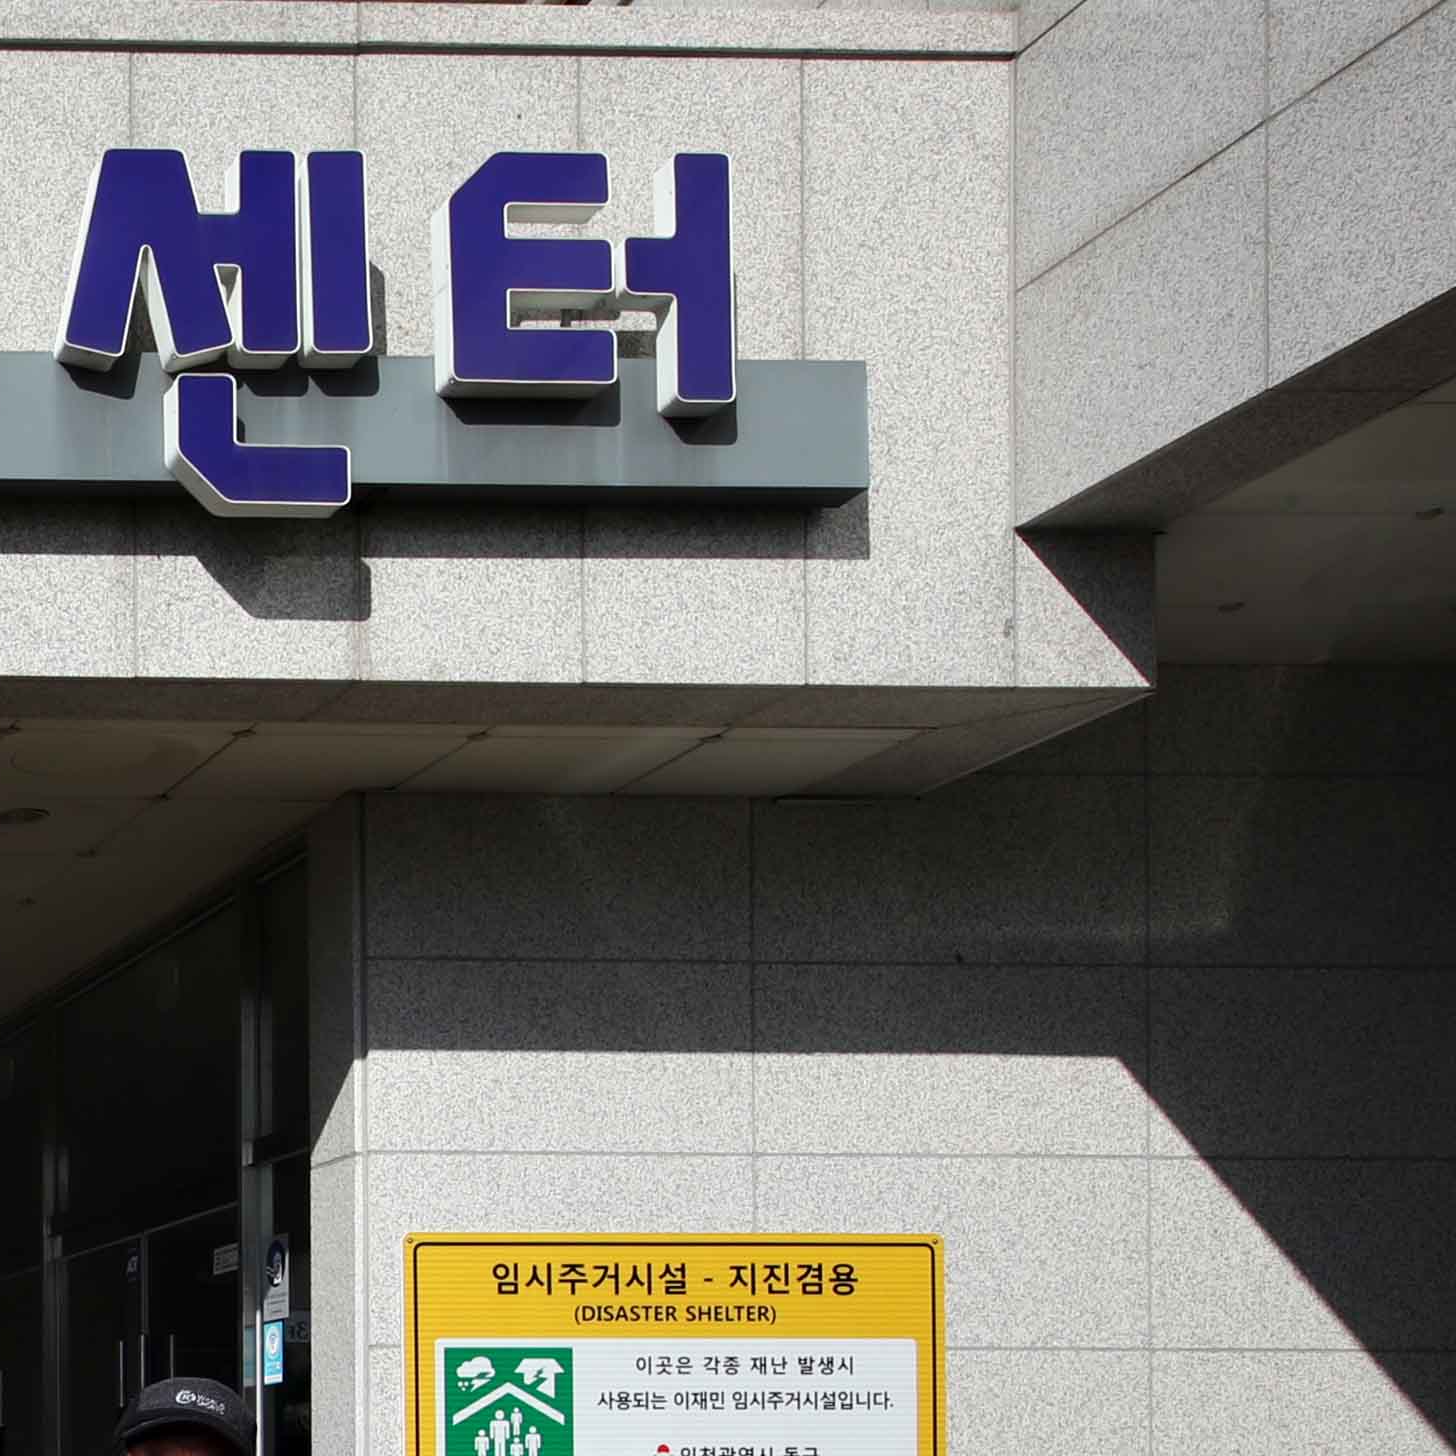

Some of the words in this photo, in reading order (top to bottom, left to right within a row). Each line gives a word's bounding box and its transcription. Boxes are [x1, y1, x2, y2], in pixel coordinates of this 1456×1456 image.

[491, 1261, 689, 1296] 임시주거시설
[728, 1261, 860, 1297] 지진겸용
[573, 1303, 679, 1326] (DISASTER
[684, 1303, 778, 1326] SHELTER)
[635, 1355, 694, 1376] 이곳은
[702, 1355, 742, 1377] 각종
[749, 1355, 789, 1376] 재난
[796, 1355, 856, 1376] 발생시
[596, 1390, 668, 1411] 사용되는
[672, 1390, 727, 1411] 이재민
[731, 1390, 896, 1411] 임시주거시설입니다.
